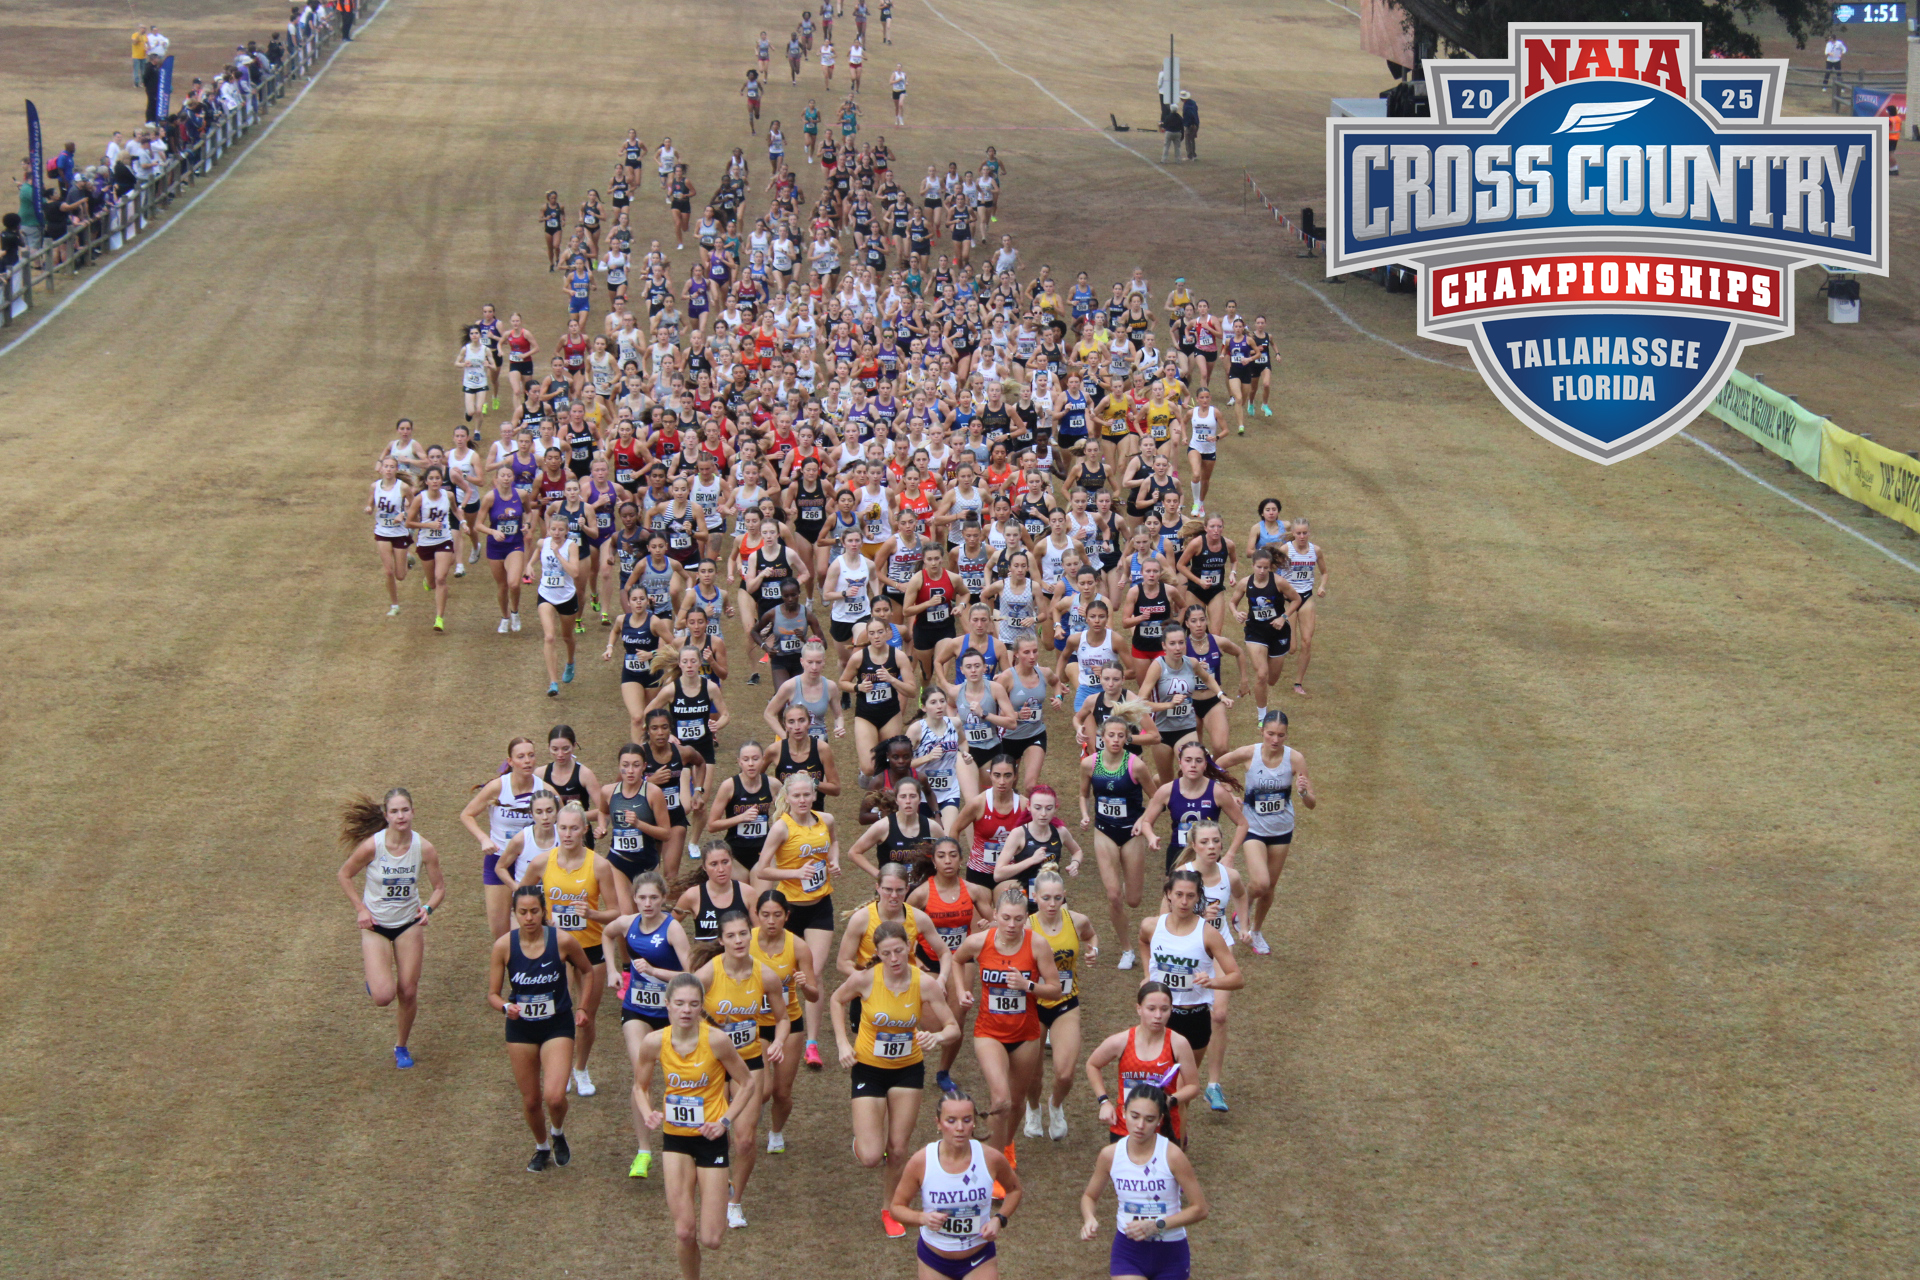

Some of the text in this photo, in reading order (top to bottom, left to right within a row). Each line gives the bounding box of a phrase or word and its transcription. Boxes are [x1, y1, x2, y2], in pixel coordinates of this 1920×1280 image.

[1863, 4, 1899, 23] 1:51
[696, 493, 717, 501] BRYAN
[501, 525, 515, 533] 357
[1027, 525, 1041, 533] 388
[674, 538, 687, 546] 145
[1296, 571, 1308, 579] 179
[546, 577, 560, 586] 427
[967, 579, 982, 587] 240
[764, 587, 779, 596] 269
[848, 603, 863, 611] 265
[932, 611, 945, 619] 116
[1257, 609, 1272, 618] 492
[1143, 627, 1159, 635] 424
[622, 635, 651, 645] Master's
[785, 640, 800, 649] 476
[629, 660, 646, 670] 468
[870, 689, 887, 701] 272
[673, 705, 709, 714] WILDCATS
[1172, 705, 1188, 716] 109
[681, 727, 701, 738] 255
[969, 730, 987, 740] 106
[930, 777, 948, 787] 295
[1103, 804, 1121, 815] 378
[1259, 801, 1280, 813] 306
[742, 823, 761, 835] 270
[618, 838, 637, 849] 199
[809, 870, 825, 887] 194
[387, 885, 410, 897] 328
[558, 914, 580, 927] 190
[1154, 952, 1199, 968] WWU
[511, 972, 560, 985] Master's
[981, 968, 1031, 983] DOAE
[1163, 973, 1186, 988] 491
[636, 991, 660, 1005] 430
[995, 996, 1018, 1010] 184
[524, 1003, 547, 1017] 472
[716, 999, 757, 1016] Dordt
[729, 1029, 750, 1046] 185
[883, 1042, 905, 1056] 187
[668, 1072, 709, 1089] Dordt
[673, 1106, 696, 1123] 191
[1116, 1178, 1166, 1192] TAYLOR
[929, 1187, 987, 1204] TAYLOR
[942, 1218, 973, 1234] 463
